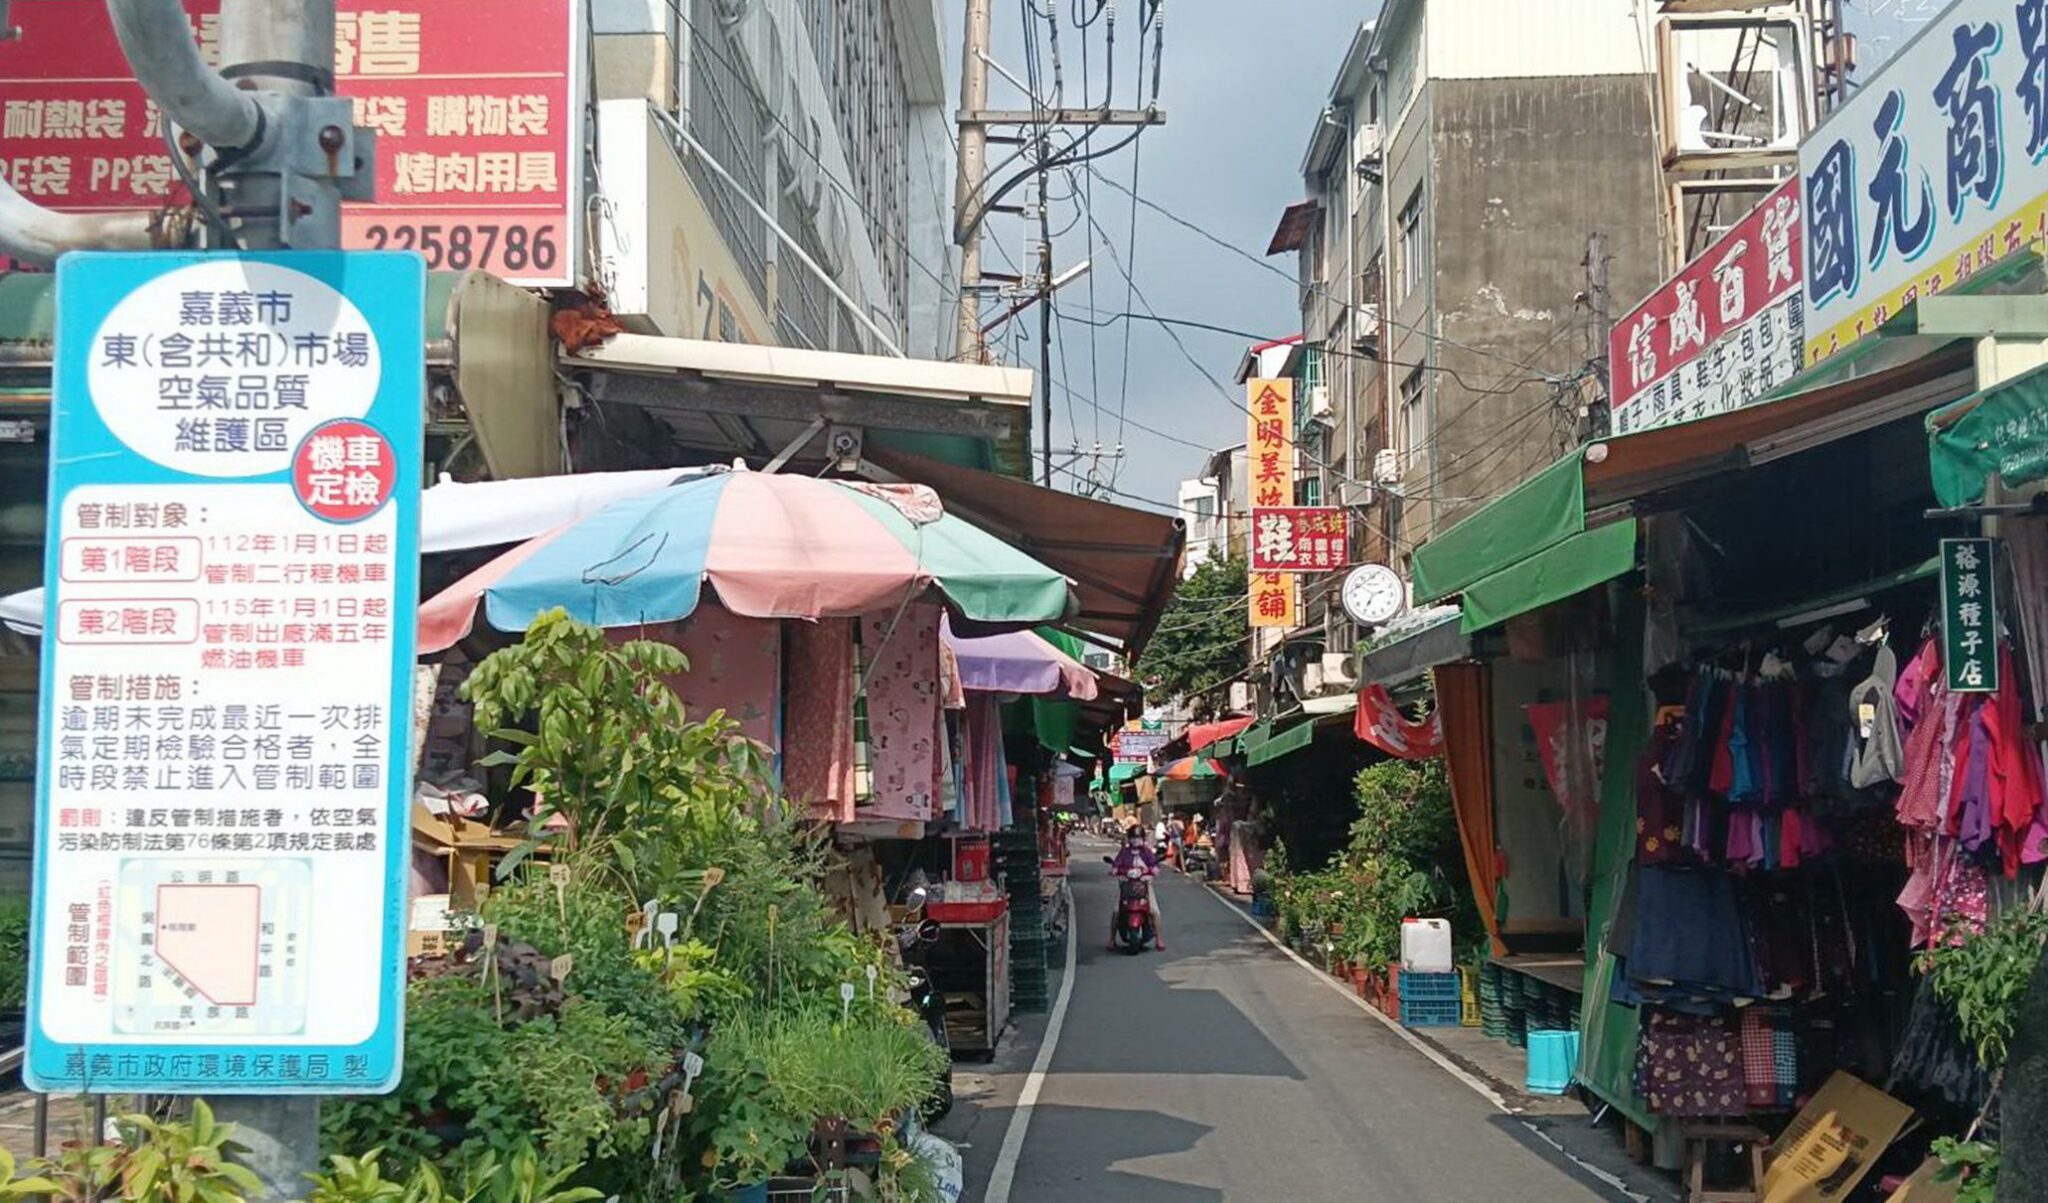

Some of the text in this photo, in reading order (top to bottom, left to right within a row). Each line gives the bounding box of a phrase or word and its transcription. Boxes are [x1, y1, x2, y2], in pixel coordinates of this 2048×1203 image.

[3, 99, 126, 139] 耐熱袋
[353, 95, 549, 136] 袋 購物袋
[90, 155, 172, 195] PP袋
[393, 152, 558, 193] 烤肉用具
[366, 225, 557, 270] 2258786
[179, 291, 293, 326] 嘉義市
[102, 333, 370, 368] 東(含共和)市場
[157, 375, 310, 411] 空氣品質
[175, 417, 289, 453] 維護區
[307, 435, 383, 471] 機車
[307, 473, 380, 507] 定檢
[207, 534, 389, 555] 112年1月1日起
[1256, 514, 1297, 562] 鞋
[80, 546, 180, 574] 第1階段
[204, 564, 387, 585] 管制二行程機車
[78, 608, 178, 636] 第2階段
[206, 597, 388, 618] 115年1月1日起
[1955, 544, 1983, 686] 裕源種子店
[202, 623, 387, 644] 管制出廠滿五年
[201, 648, 306, 669] 燃油機車
[61, 704, 383, 732] 逾期未完成最近一次排
[59, 734, 382, 762] 氣定期檢驗合格者，全
[58, 764, 381, 791] 時段禁止進入管制範圍
[65, 902, 91, 986] 管制範圍
[64, 1052, 369, 1079] 嘉義市政府環境保護局 製
